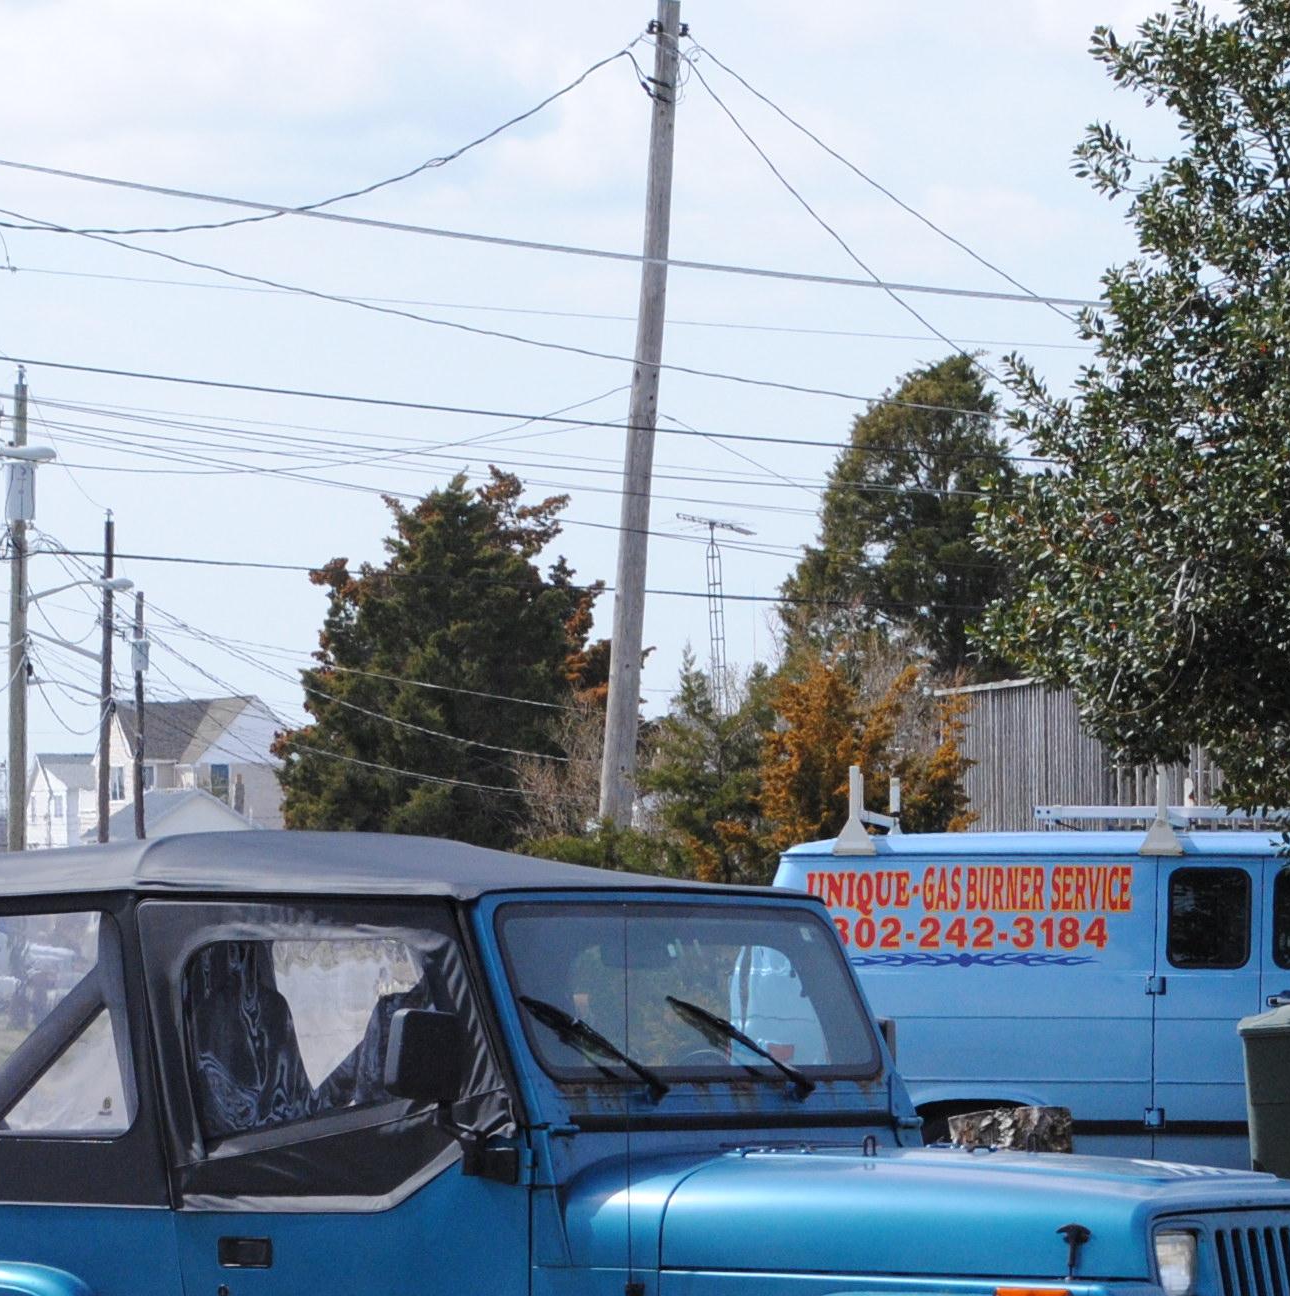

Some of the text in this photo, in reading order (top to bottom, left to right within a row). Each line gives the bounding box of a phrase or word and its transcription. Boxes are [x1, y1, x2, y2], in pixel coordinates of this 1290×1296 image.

[965, 866, 1045, 911] BURNER
[1050, 865, 1133, 912] SERVICE
[833, 916, 1108, 949] 302-242-3184
